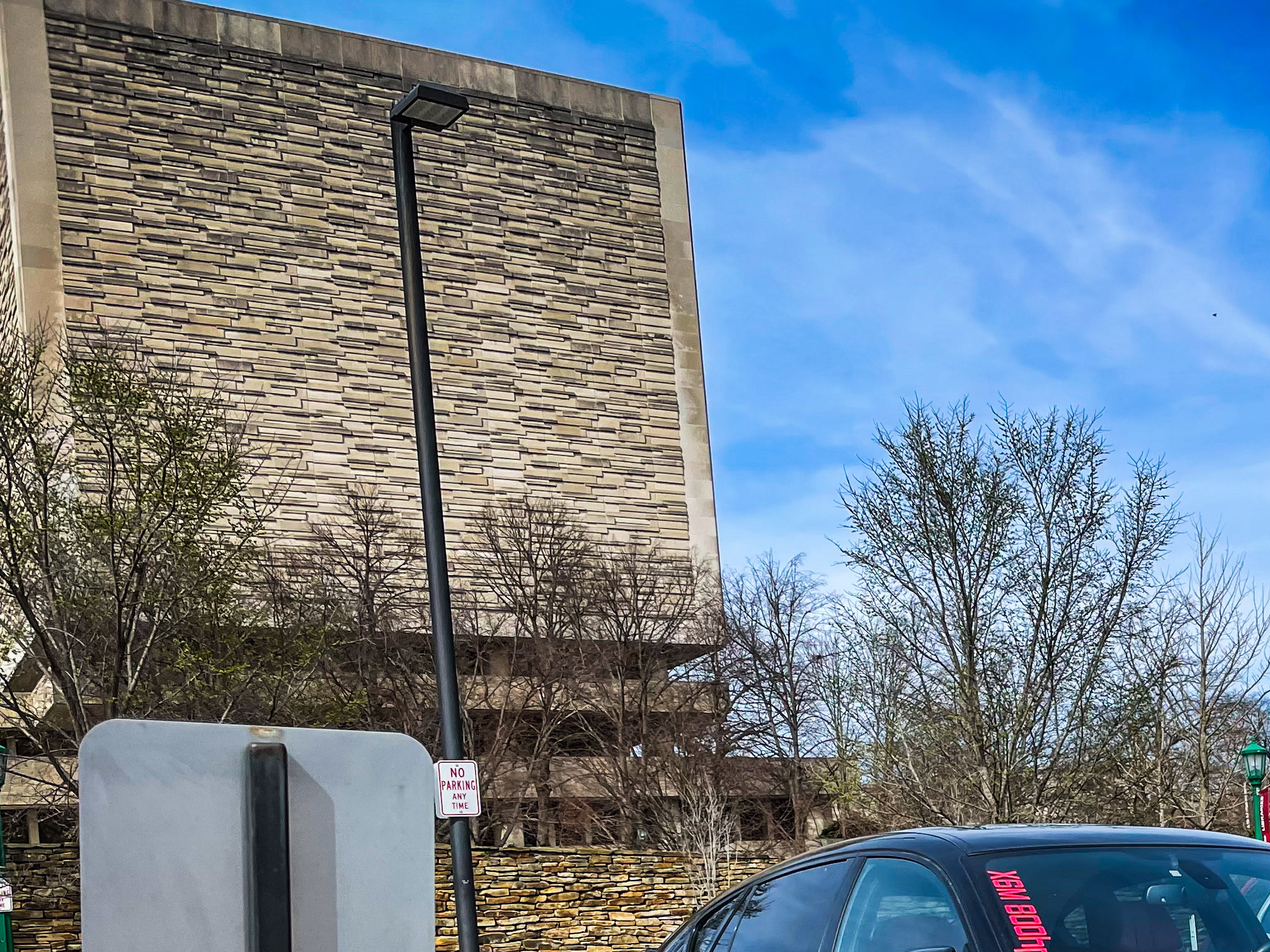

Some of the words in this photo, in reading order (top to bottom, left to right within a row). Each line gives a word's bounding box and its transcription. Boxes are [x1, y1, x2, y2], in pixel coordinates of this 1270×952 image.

[450, 767, 465, 778] NO
[441, 780, 476, 790] PARKING
[452, 802, 469, 810] TIME
[986, 870, 1031, 900] X6M
